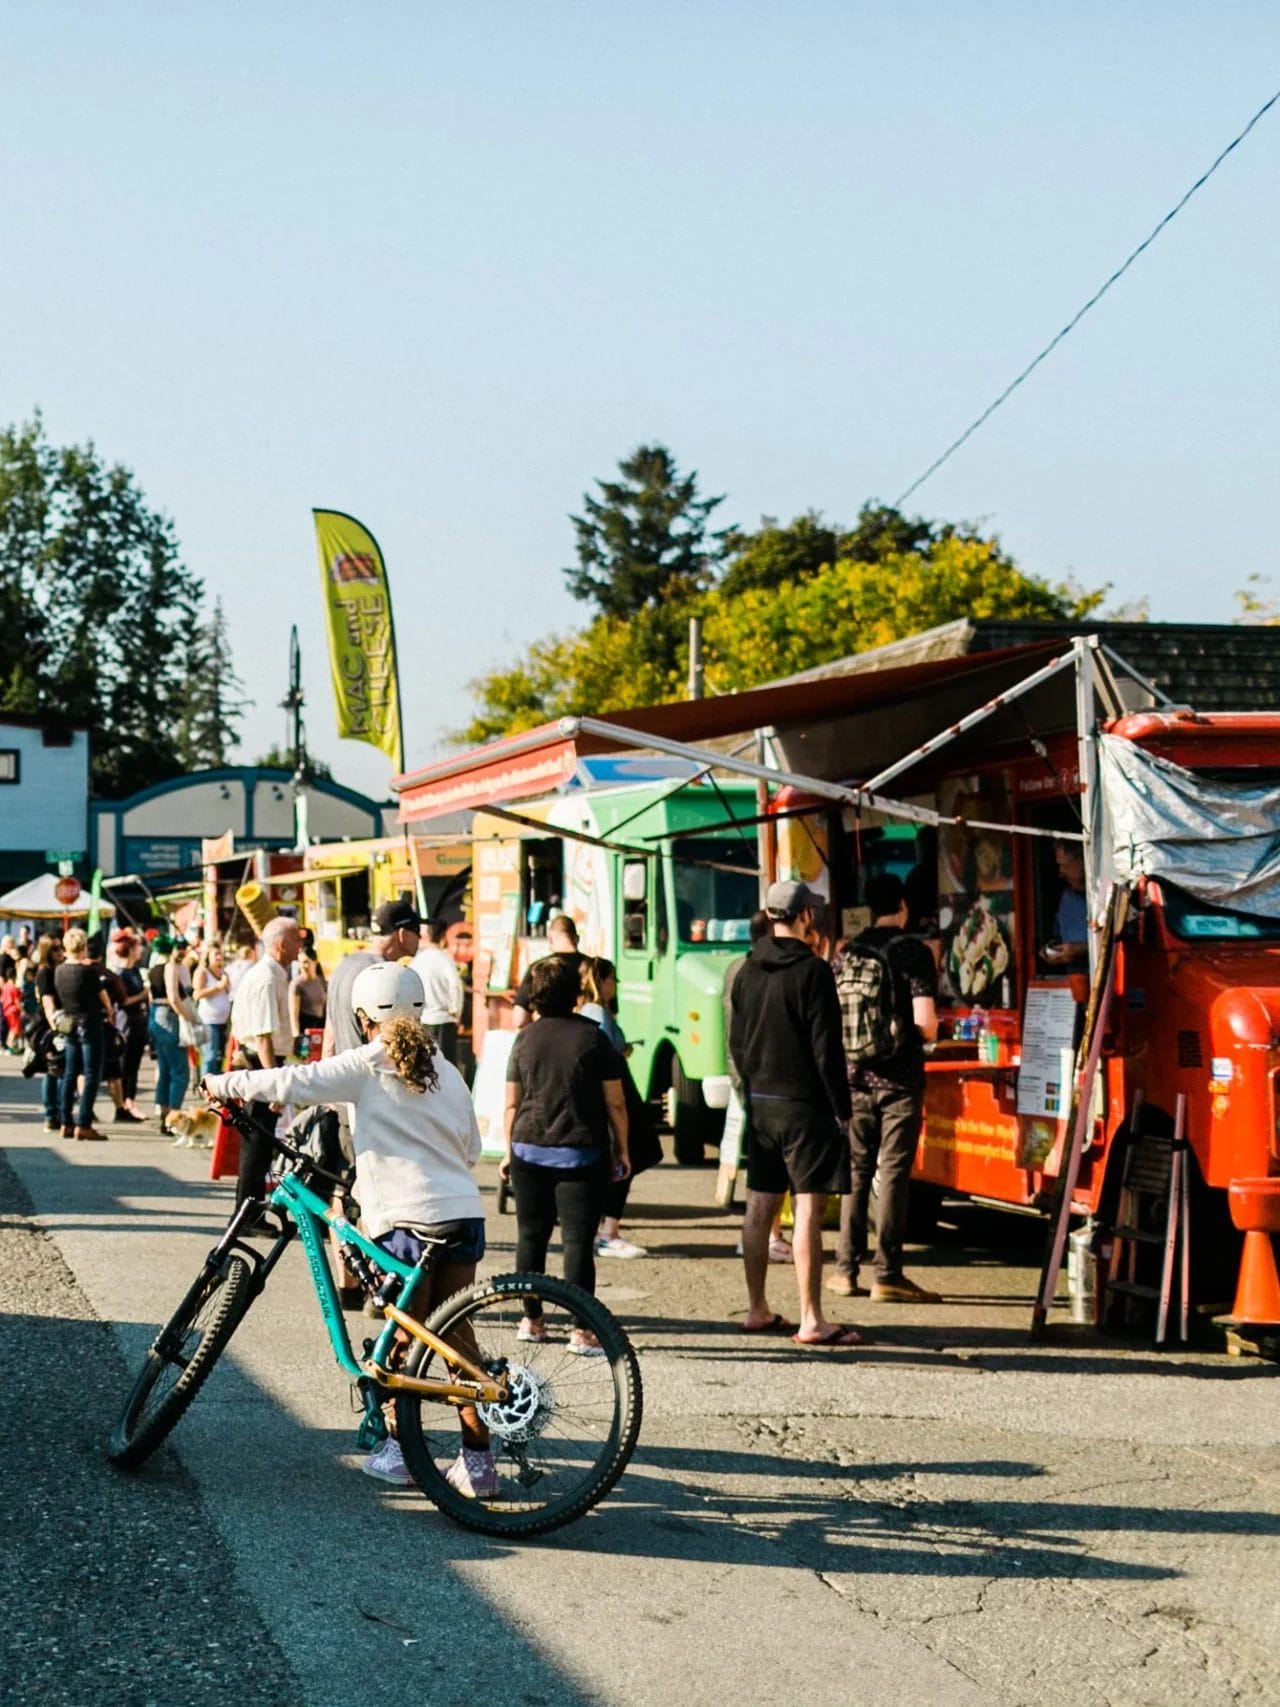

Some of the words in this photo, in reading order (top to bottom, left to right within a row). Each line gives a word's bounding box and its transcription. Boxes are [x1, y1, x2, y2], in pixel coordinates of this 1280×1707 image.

[335, 599, 363, 647] and
[343, 654, 370, 734] MAC
[361, 594, 394, 736] CHEESE
[298, 1212, 316, 1253] ROCKY
[310, 1254, 333, 1319] MOUNTAIN
[472, 1282, 533, 1301] MAXXIS
